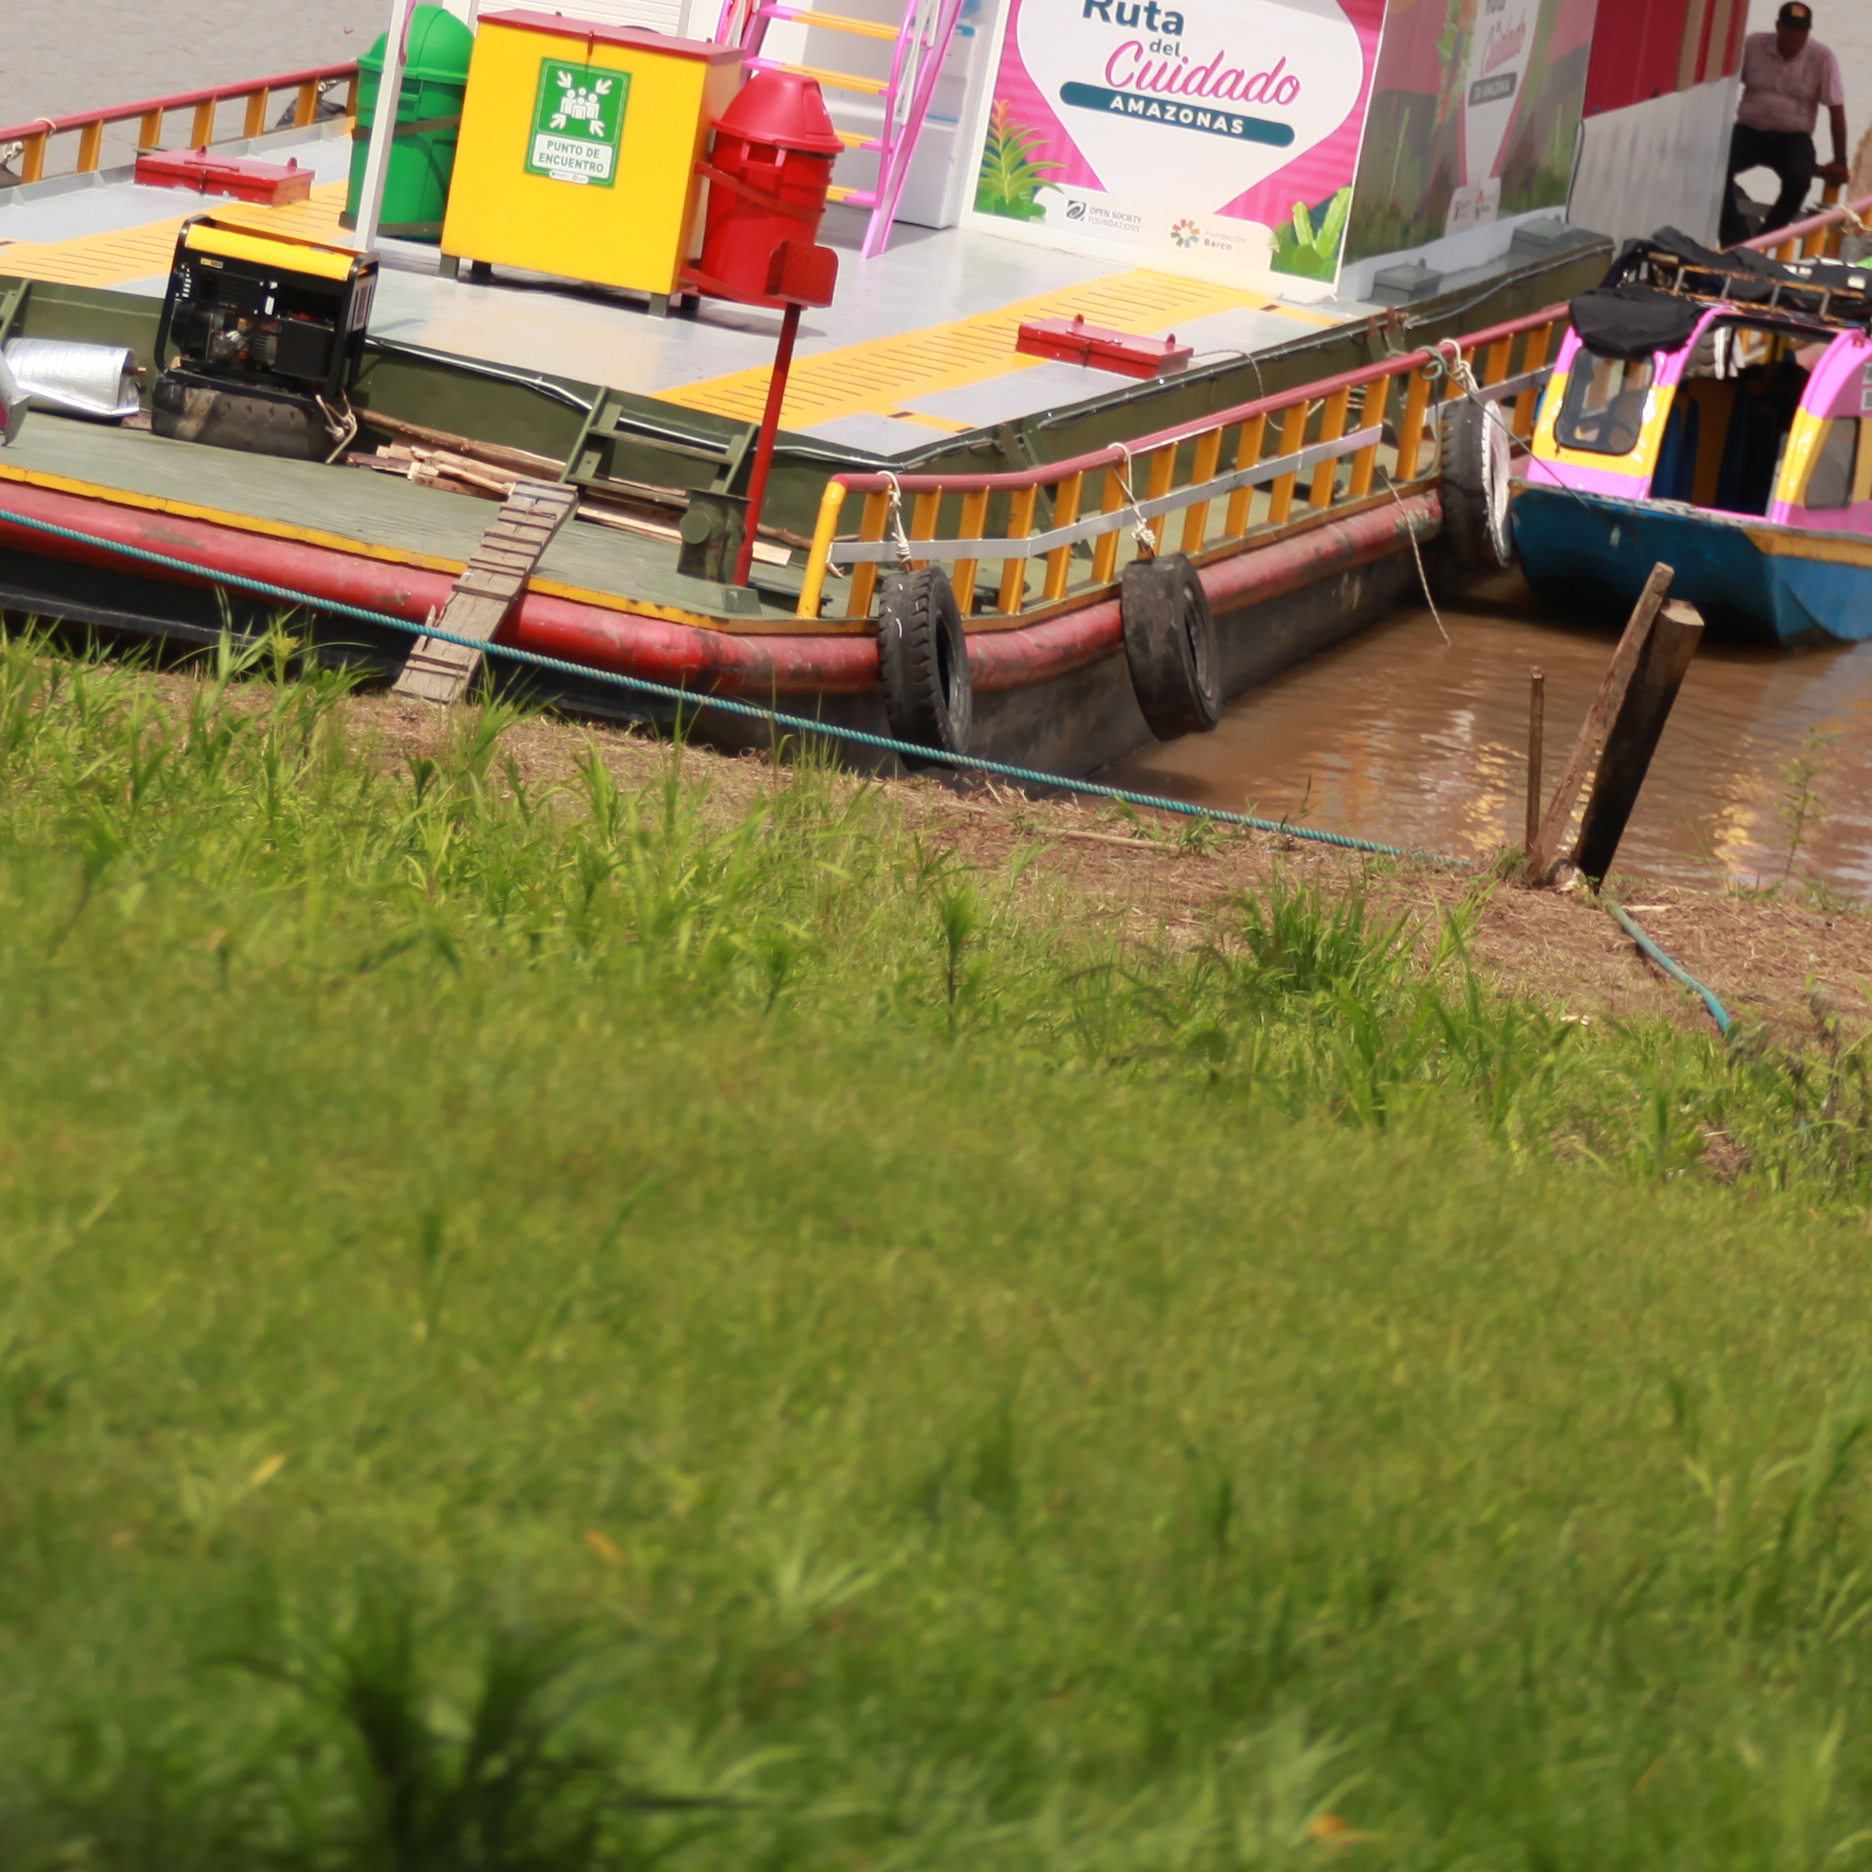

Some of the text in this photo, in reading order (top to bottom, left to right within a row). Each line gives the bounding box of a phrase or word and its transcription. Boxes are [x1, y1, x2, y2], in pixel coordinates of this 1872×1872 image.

[1149, 38, 1180, 57] del
[1105, 40, 1302, 106] Cuidado
[1110, 95, 1244, 134] AMAZONAS
[546, 140, 600, 159] PUNTO DE
[538, 152, 604, 173] ENCUENTRO
[1089, 206, 1142, 224] OPEN SOCIETY
[1203, 239, 1232, 251] Barco
